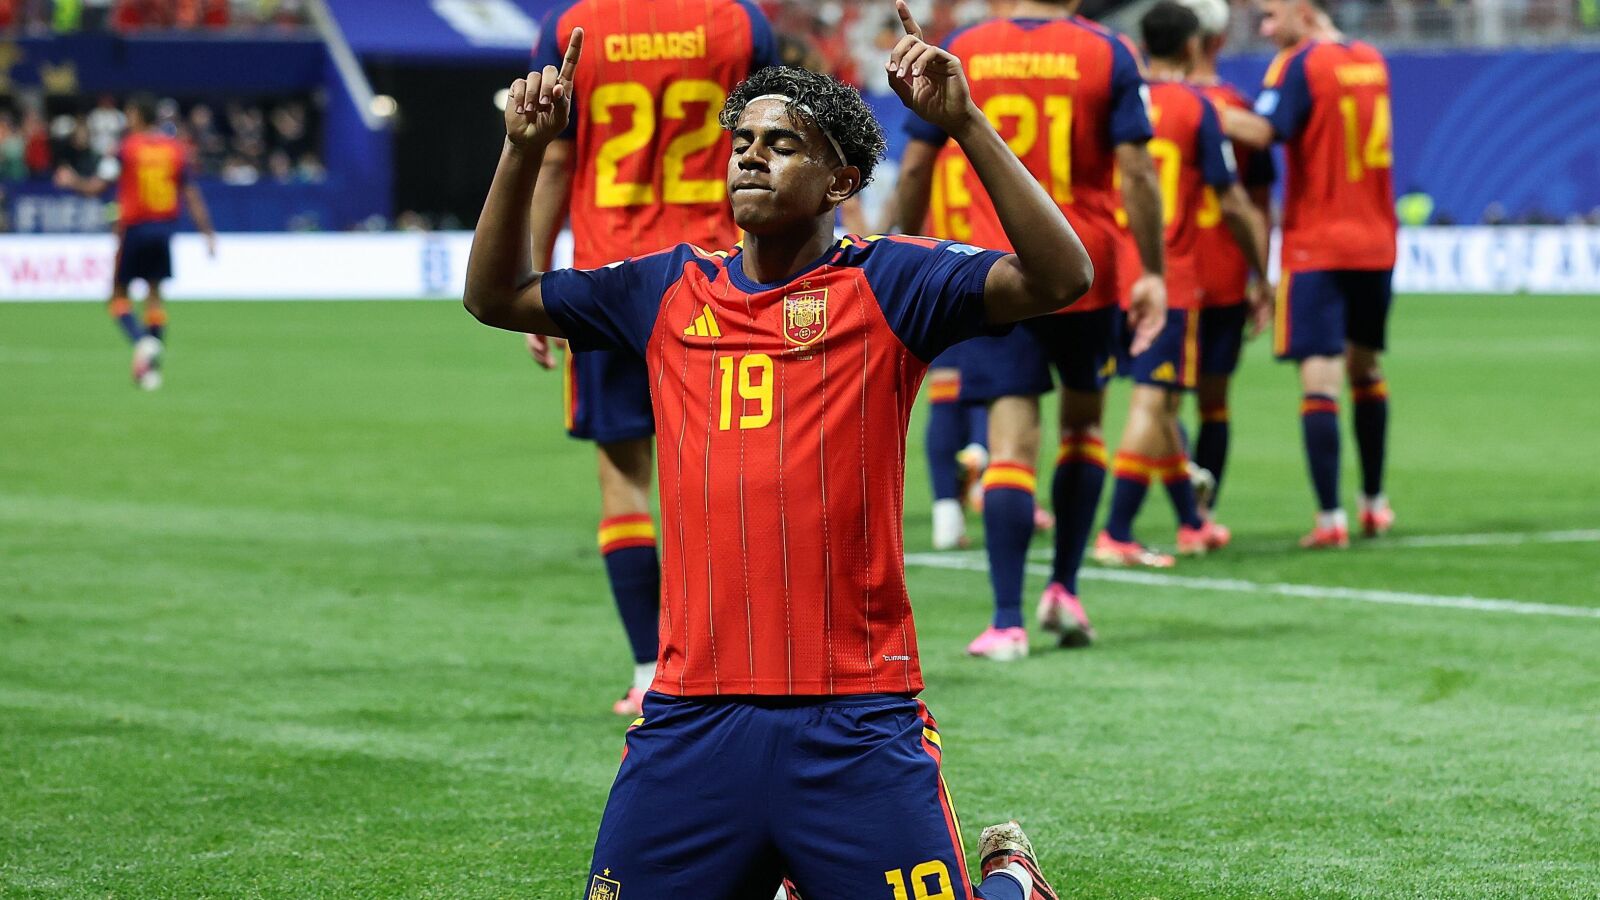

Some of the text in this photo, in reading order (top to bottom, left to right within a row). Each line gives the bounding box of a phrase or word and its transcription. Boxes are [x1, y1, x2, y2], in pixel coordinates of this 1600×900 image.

[605, 25, 706, 62] CUBARSÍ
[968, 53, 1079, 80] OYARZABAL
[590, 79, 726, 208] 22
[1340, 95, 1392, 182] 14
[719, 353, 774, 431] 19
